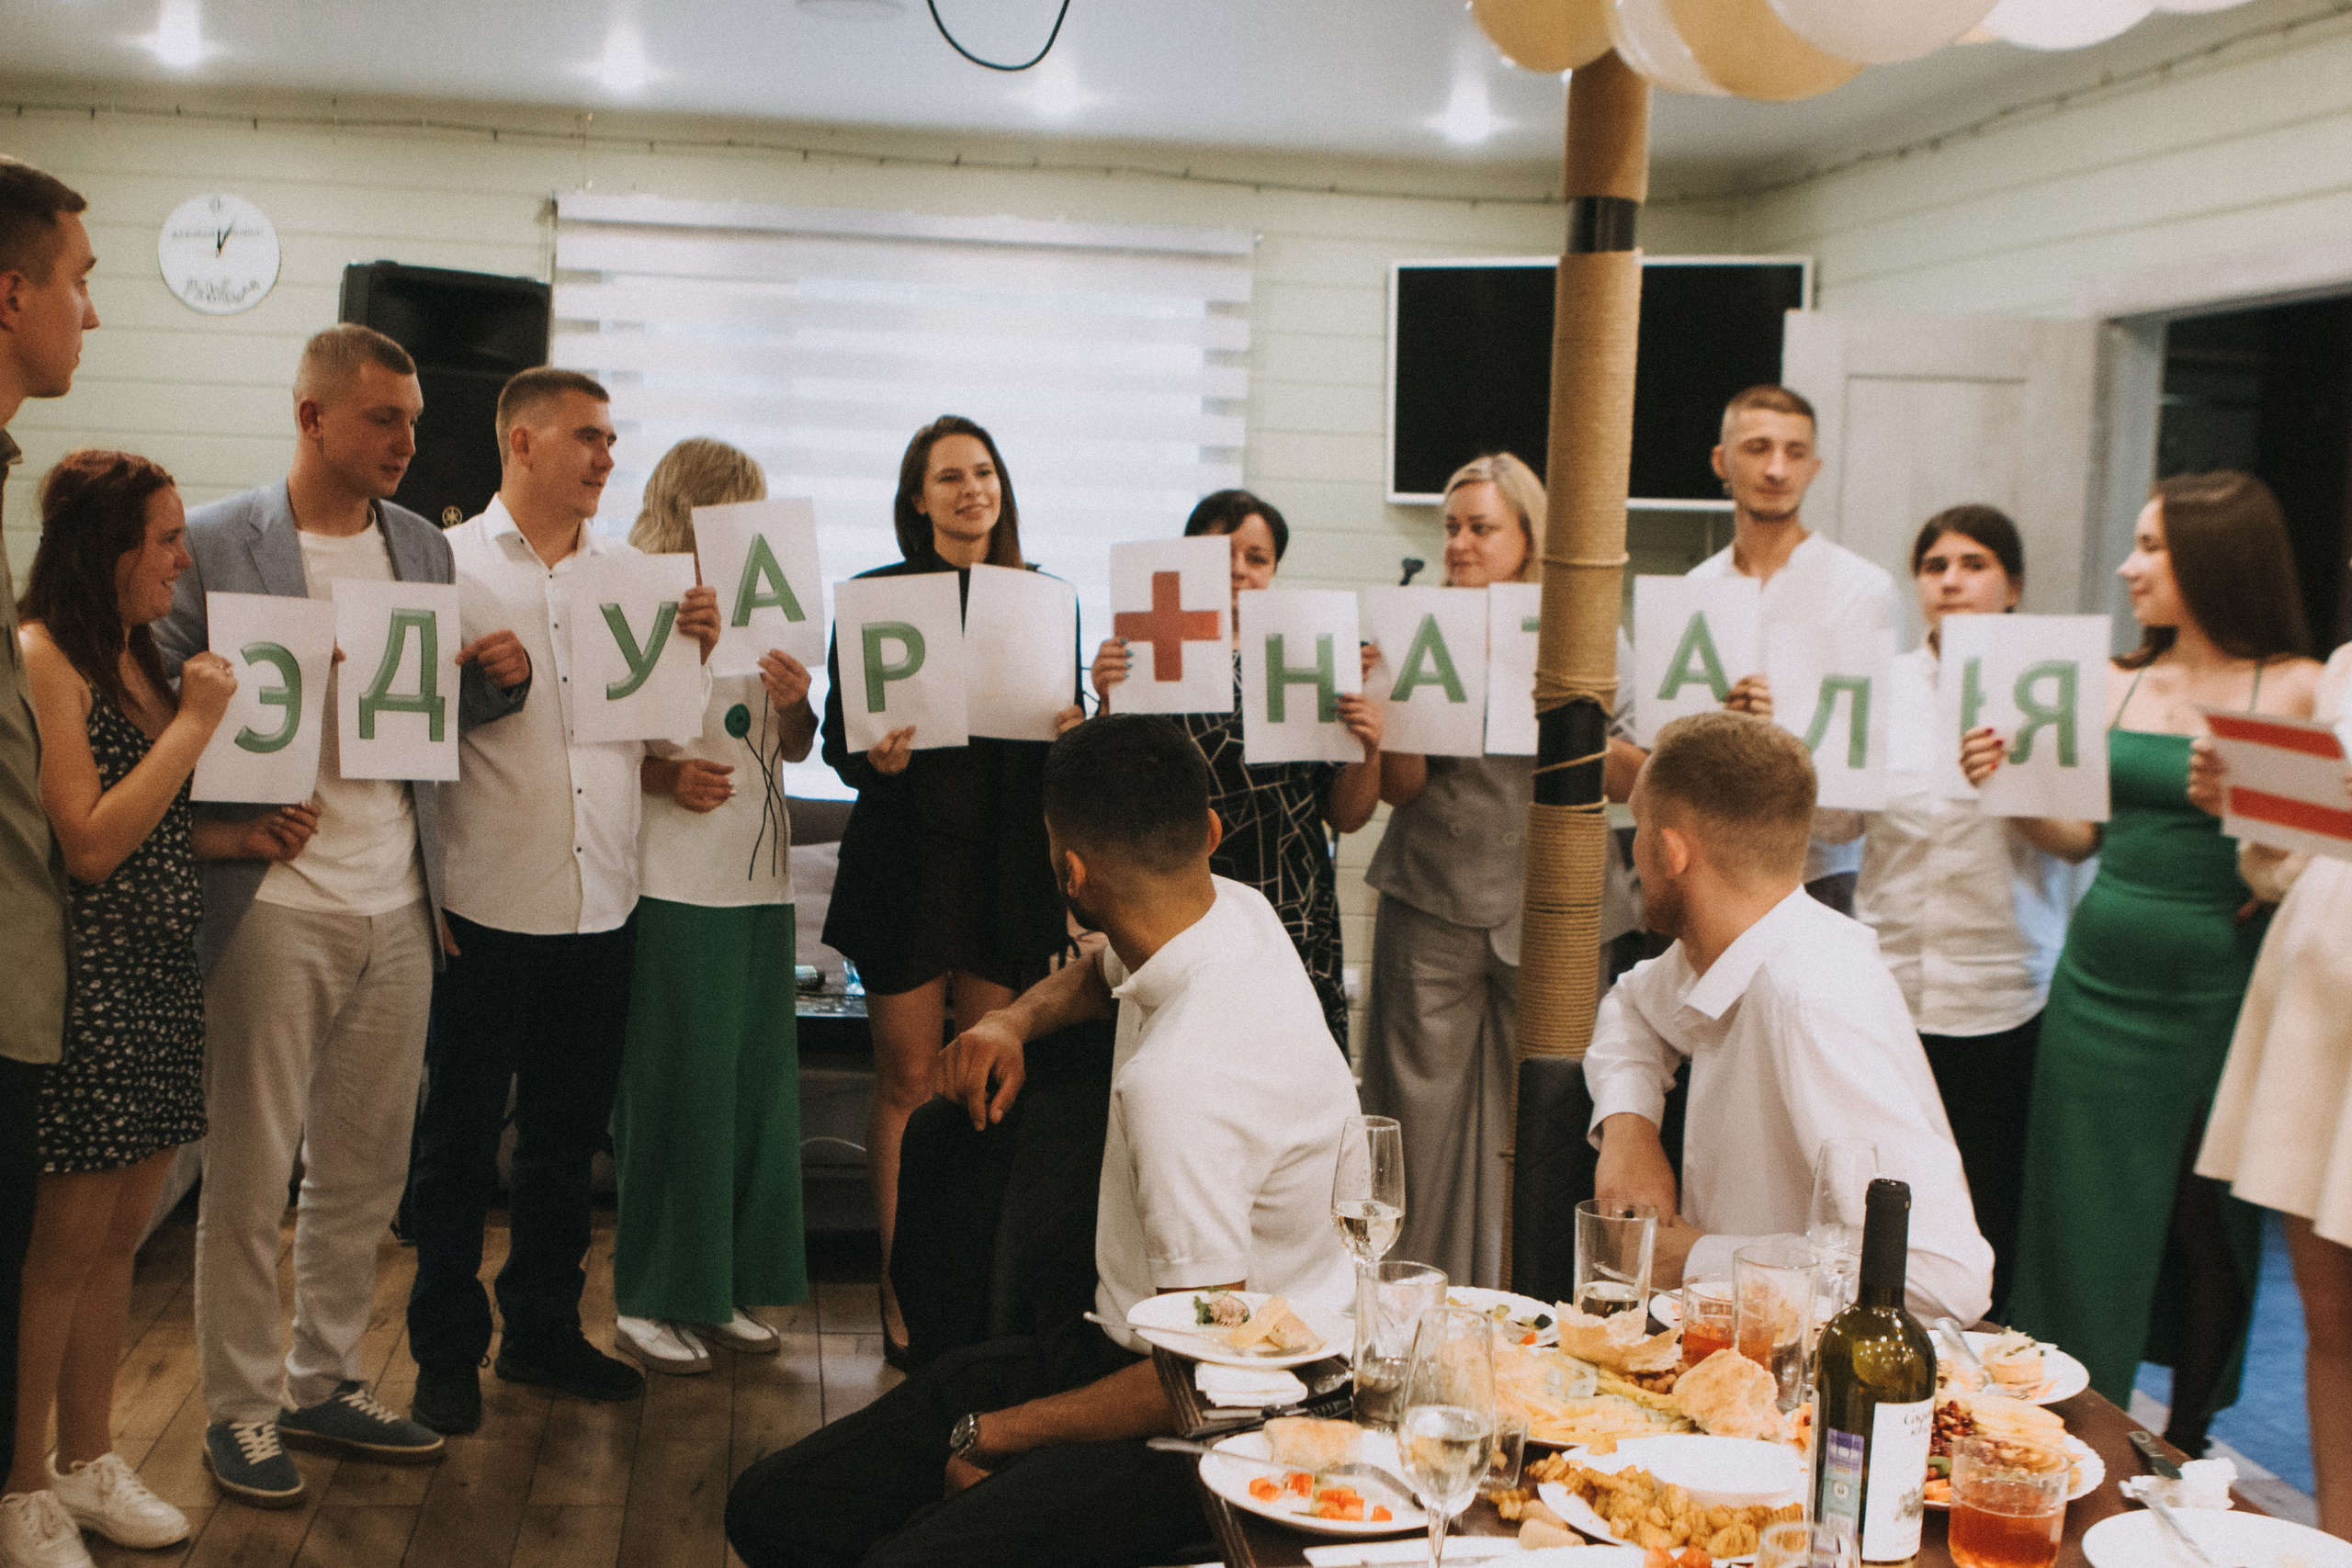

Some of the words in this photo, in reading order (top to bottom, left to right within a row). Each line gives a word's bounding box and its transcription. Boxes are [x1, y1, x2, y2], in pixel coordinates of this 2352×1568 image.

[731, 533, 806, 626] А
[233, 641, 302, 753] Э
[358, 607, 446, 742] Д
[599, 601, 679, 701] У
[861, 621, 926, 714] Р
[1265, 632, 1337, 724] Н
[1389, 613, 1468, 704] А
[1657, 611, 1730, 701] А
[1803, 675, 1872, 770] Л
[2008, 660, 2080, 768] Я
